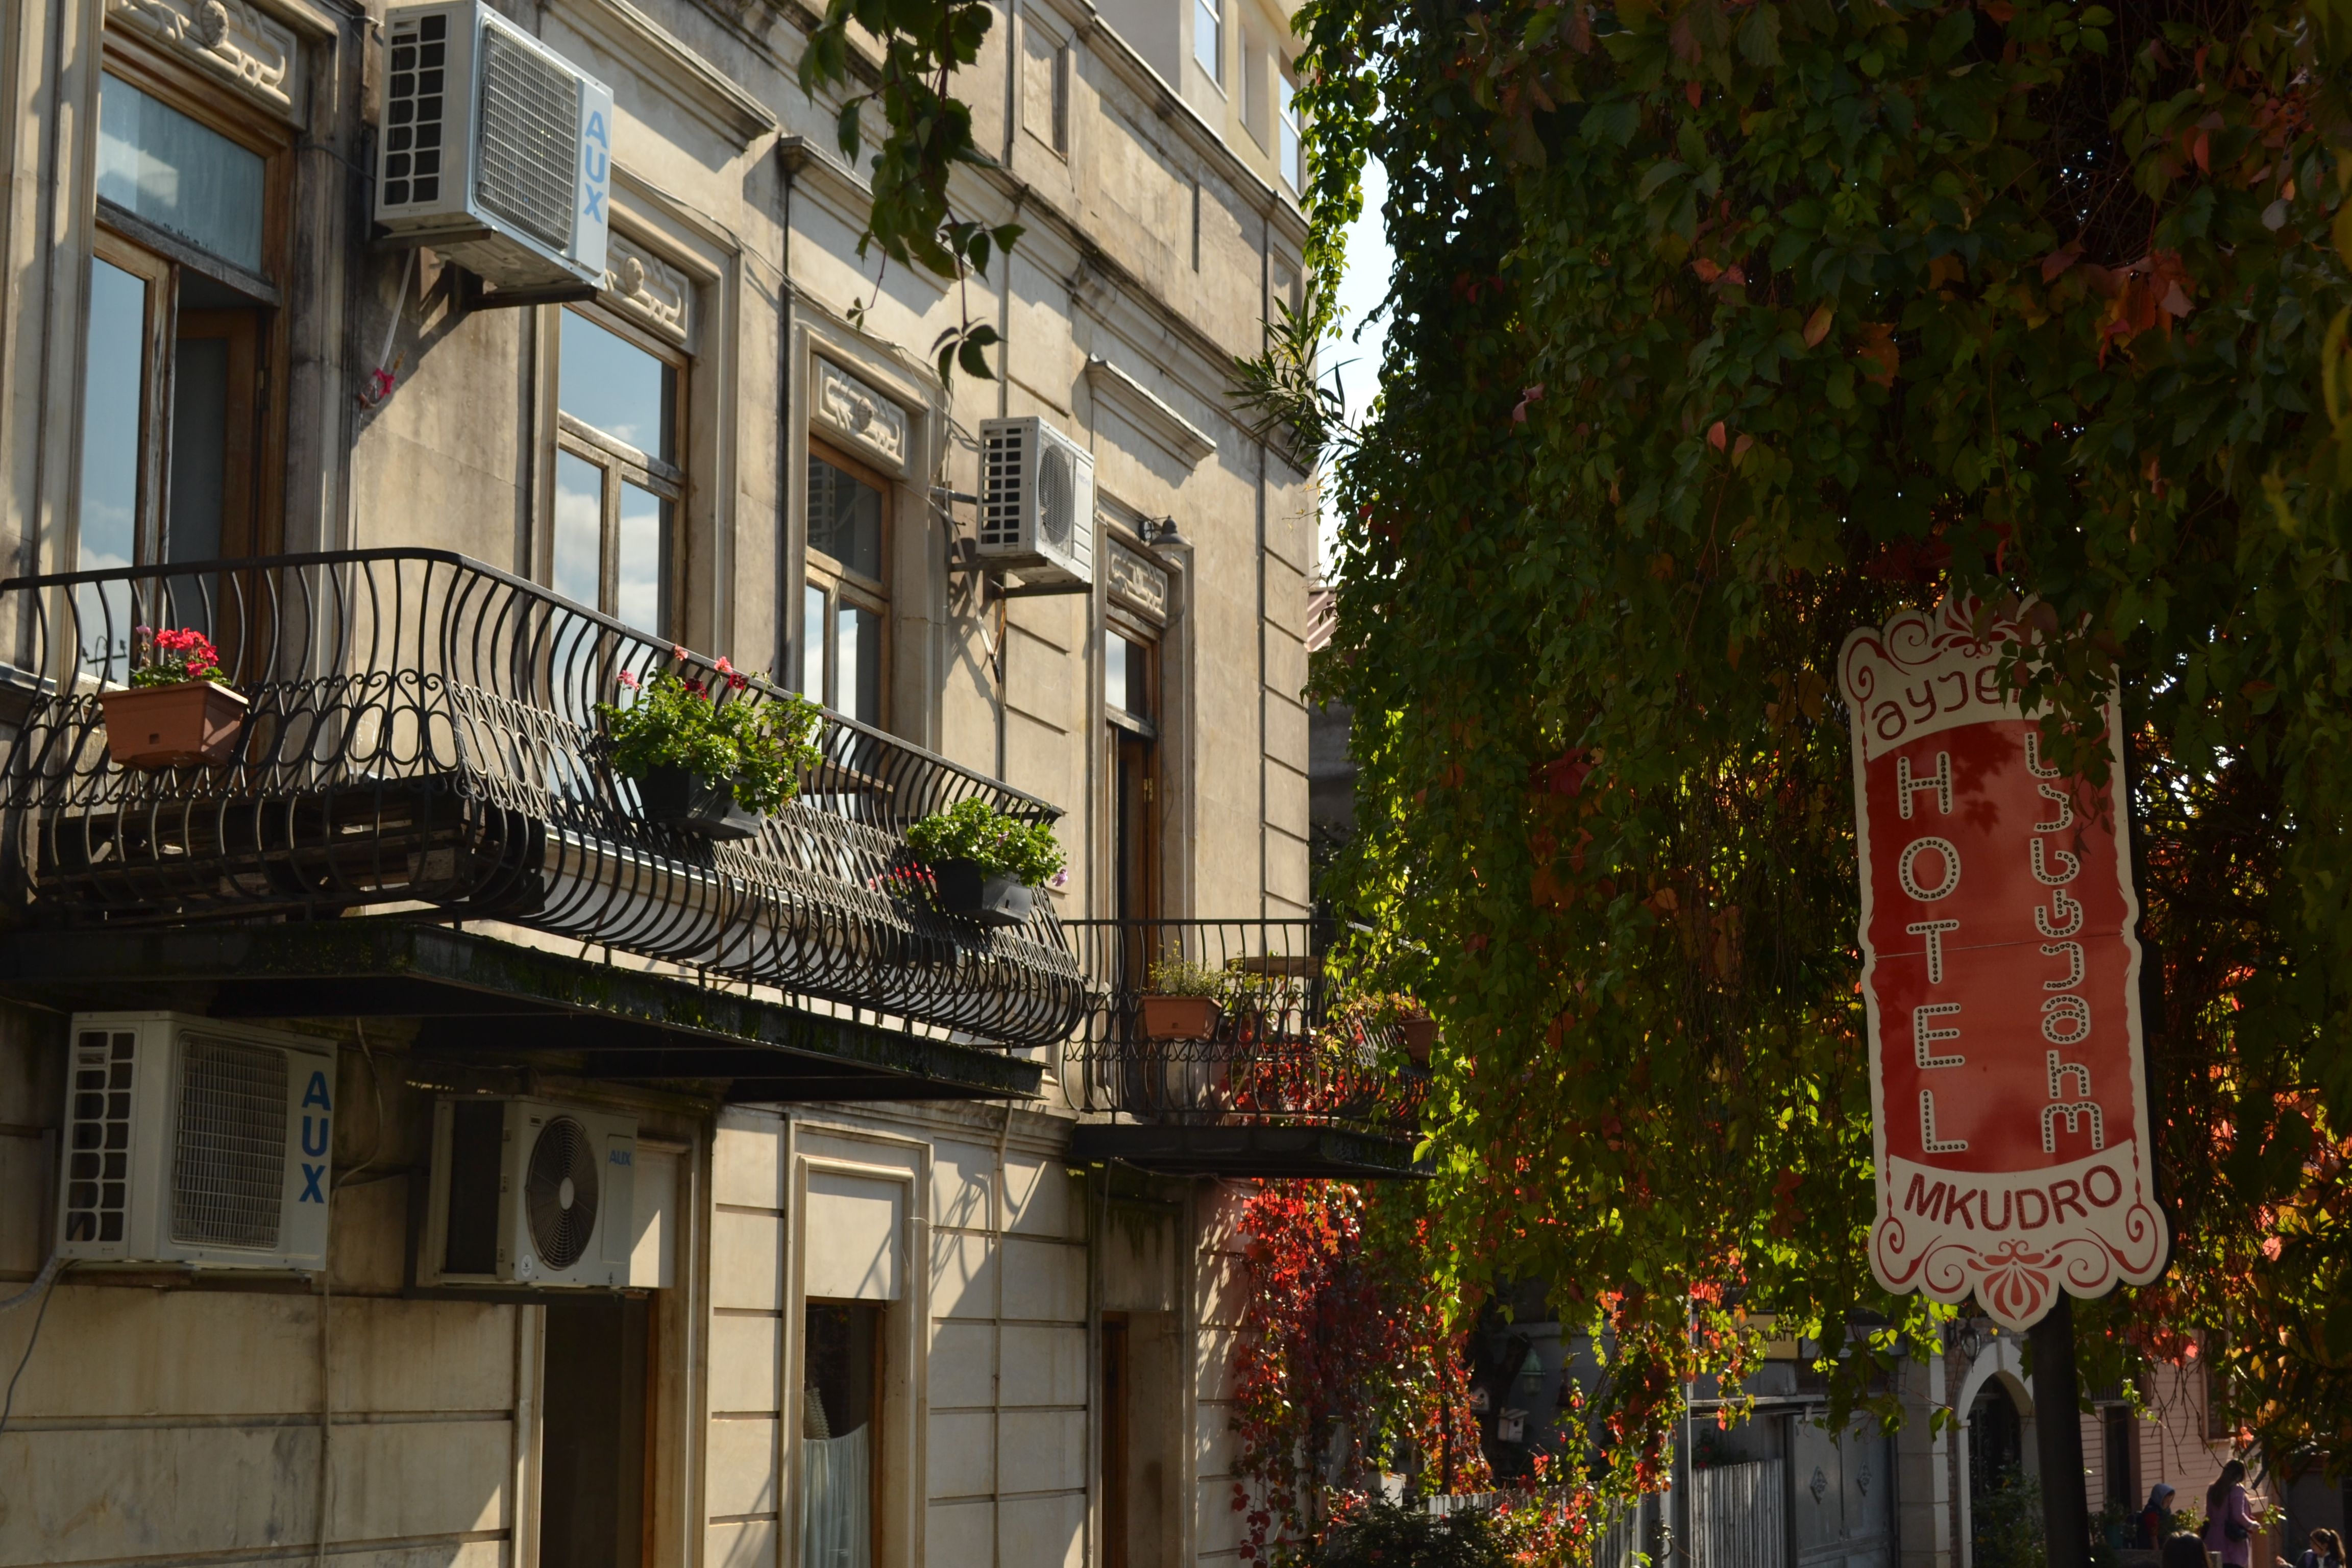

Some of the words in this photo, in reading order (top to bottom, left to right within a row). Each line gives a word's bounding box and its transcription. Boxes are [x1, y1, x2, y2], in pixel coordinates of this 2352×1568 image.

[583, 110, 608, 224] AUX
[1871, 664, 2062, 741] მყუდ
[1896, 750, 1969, 1154] HOTEL
[299, 1070, 332, 1204] AUX
[608, 1149, 632, 1167] AUX
[1903, 1164, 2123, 1232] MKUDRO
[1756, 1329, 1796, 1342] ALATY
